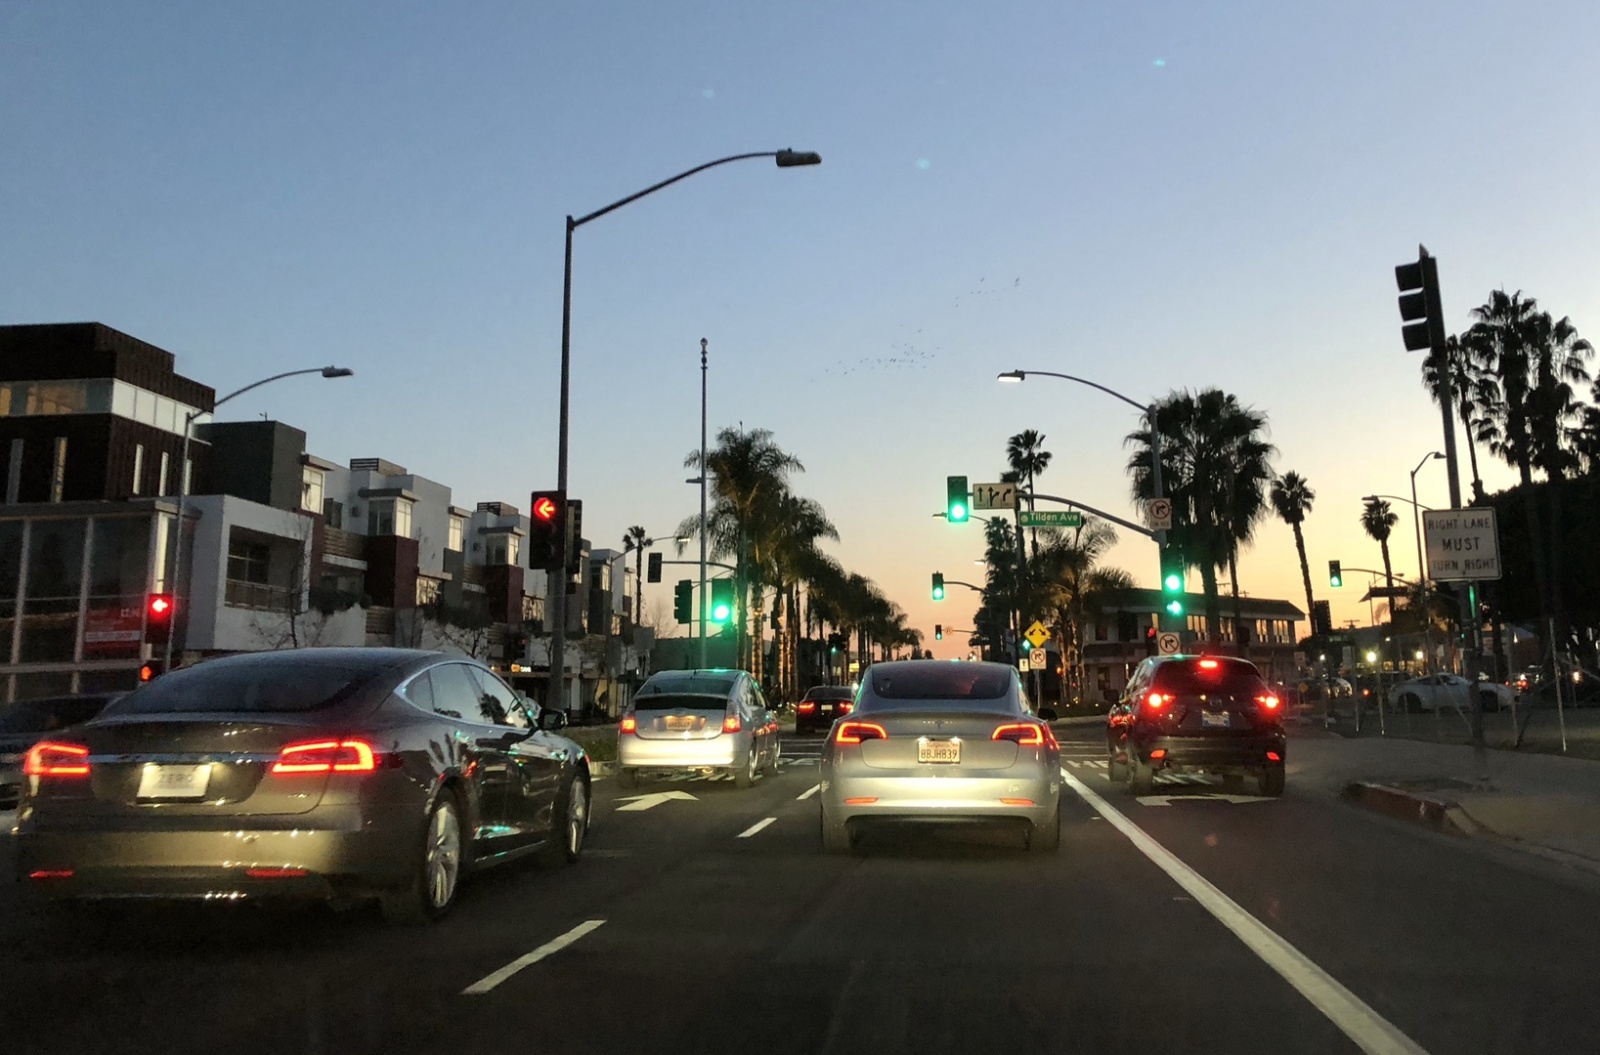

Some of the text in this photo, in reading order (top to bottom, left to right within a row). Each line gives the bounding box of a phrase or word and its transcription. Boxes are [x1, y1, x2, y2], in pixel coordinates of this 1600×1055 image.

[1030, 512, 1078, 521] Tilden Ave
[1428, 517, 1491, 530] RIGHT LANE
[1442, 536, 1480, 551] MUST
[1432, 558, 1495, 571] TURN RIGHT
[921, 749, 958, 760] 8BJH839
